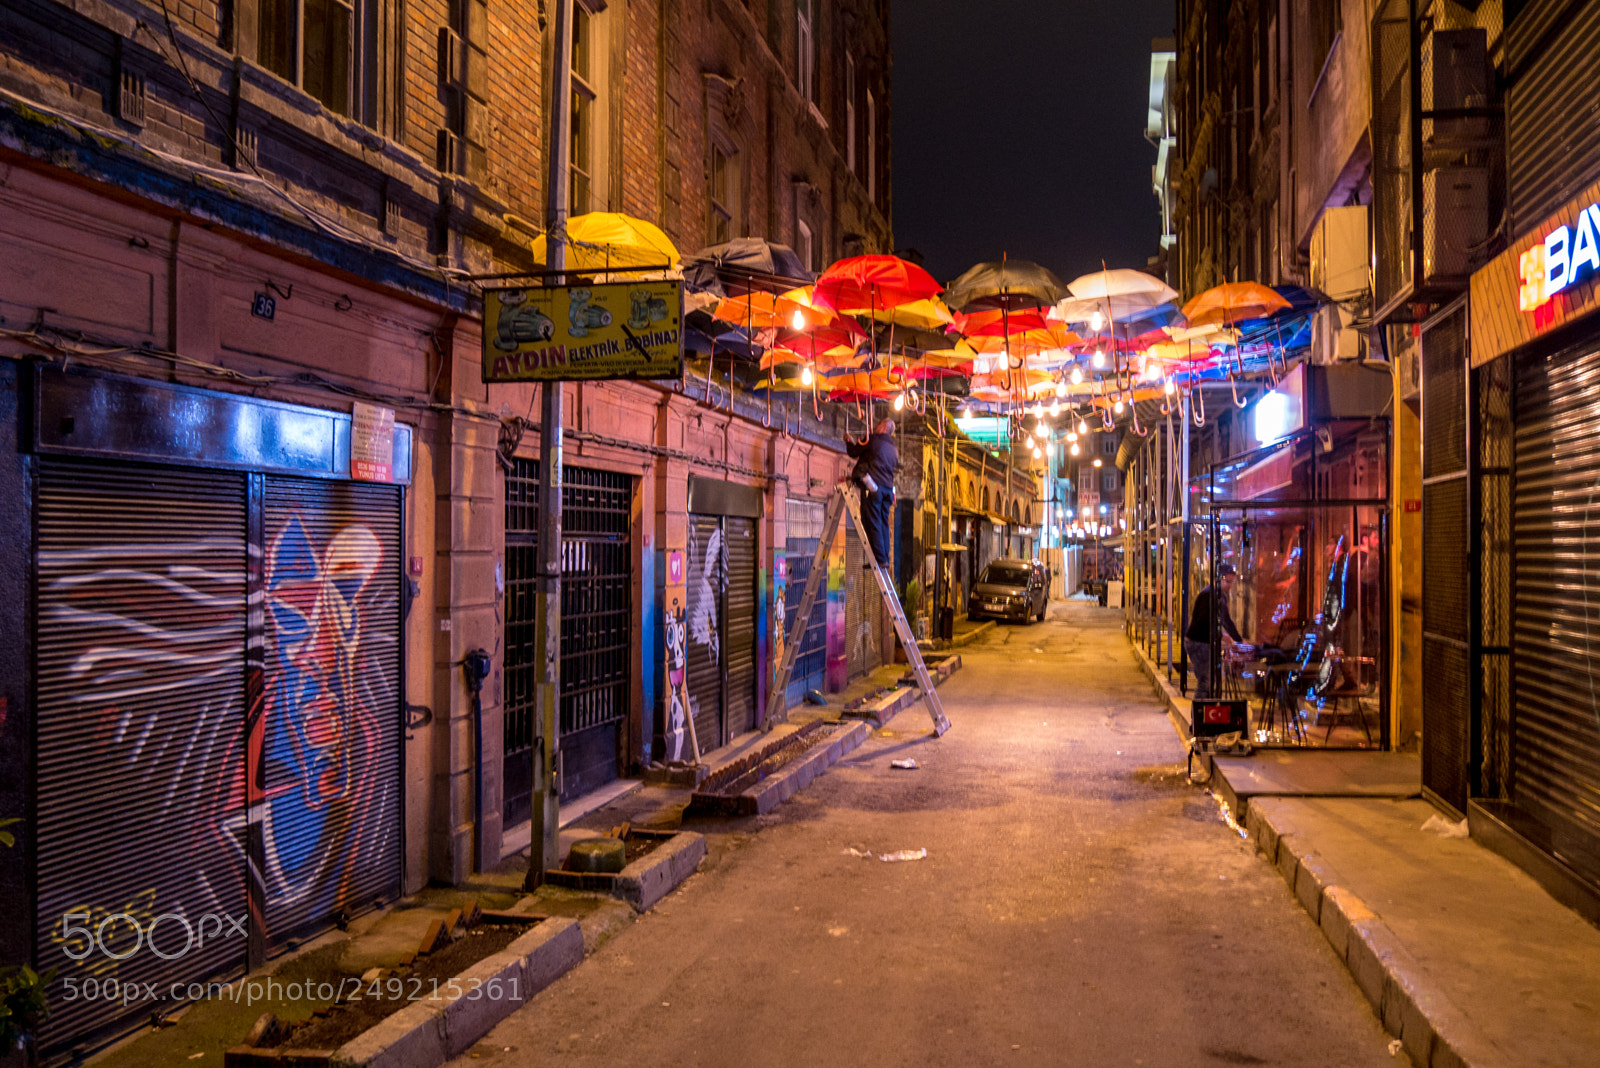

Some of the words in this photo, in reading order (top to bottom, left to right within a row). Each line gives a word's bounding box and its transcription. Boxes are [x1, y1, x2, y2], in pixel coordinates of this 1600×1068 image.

[257, 296, 273, 317] 36
[492, 344, 567, 379] AYDIN
[568, 338, 620, 362] ELEKTRİK
